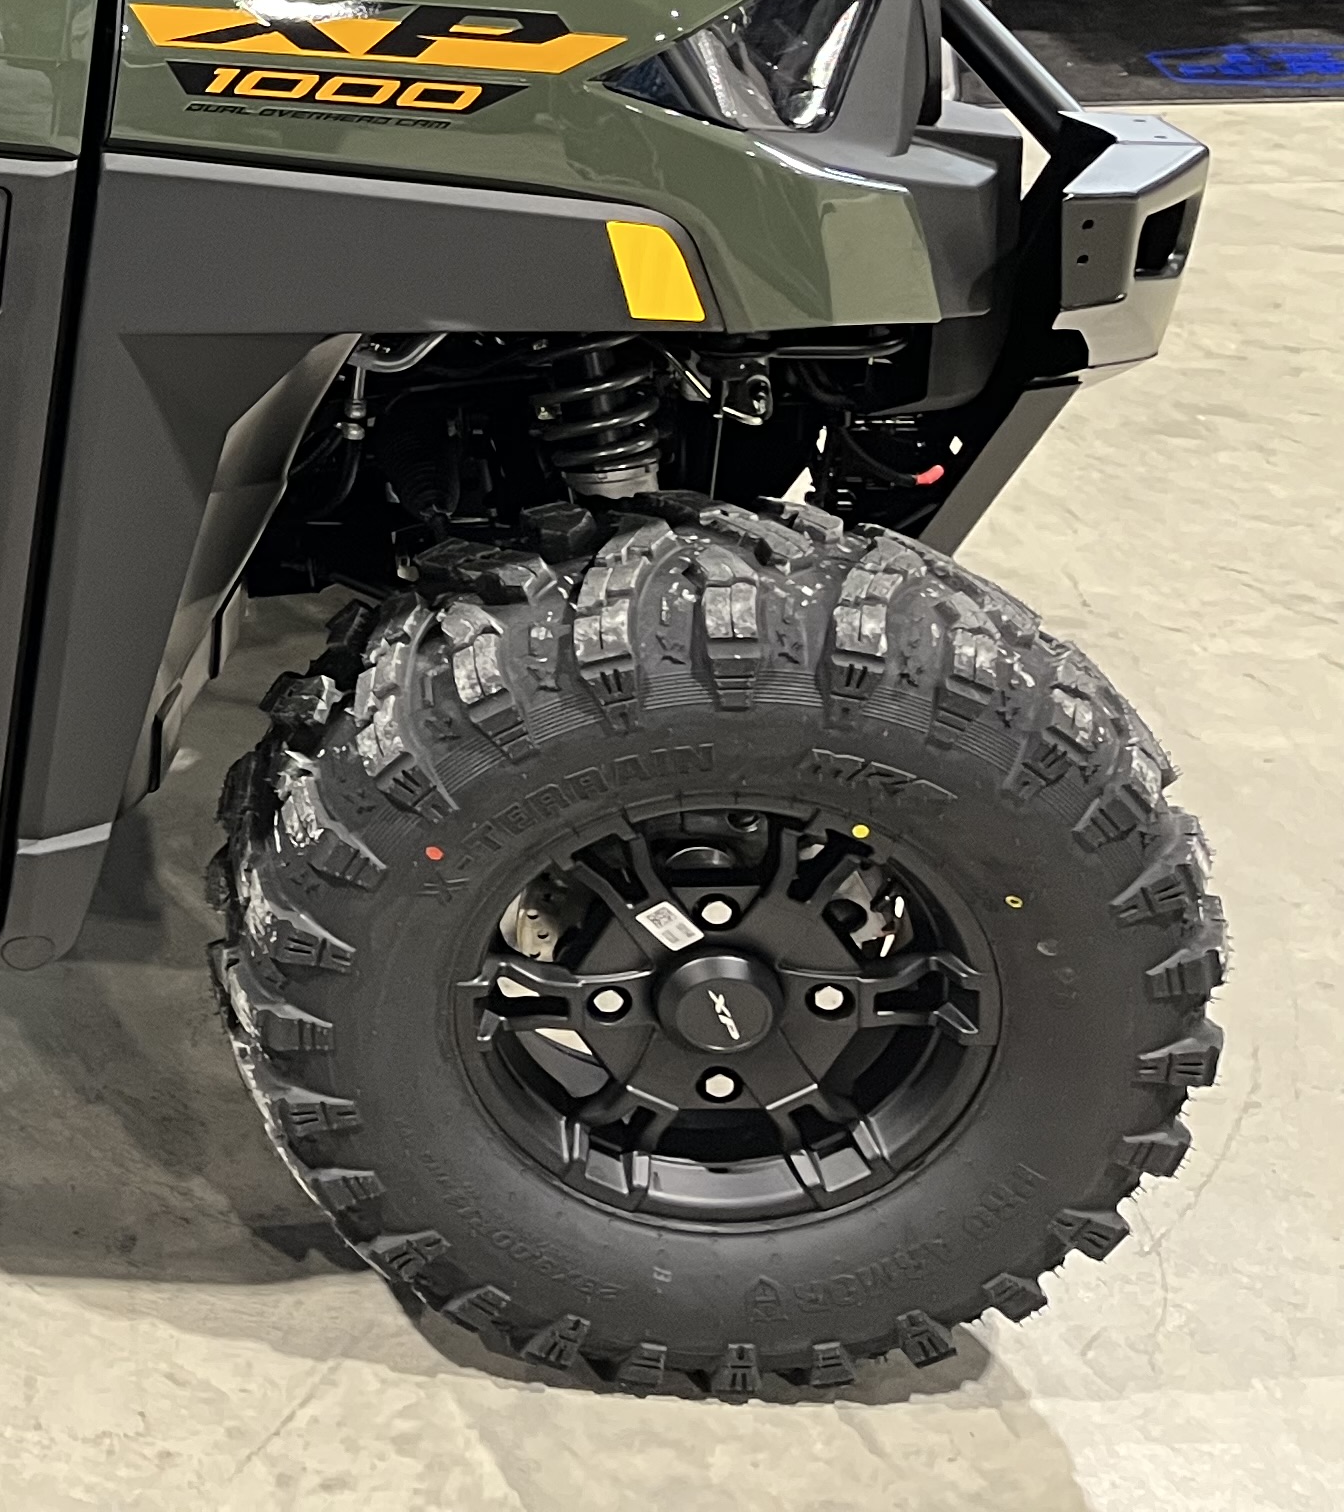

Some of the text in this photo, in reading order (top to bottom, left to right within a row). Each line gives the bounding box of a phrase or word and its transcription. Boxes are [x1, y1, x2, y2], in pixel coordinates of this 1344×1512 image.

[203, 66, 484, 113] 1000
[185, 102, 453, 131] DUAL OVERHEAD CAM
[417, 742, 716, 904] X-TERRAIN
[707, 989, 741, 1041] XP
